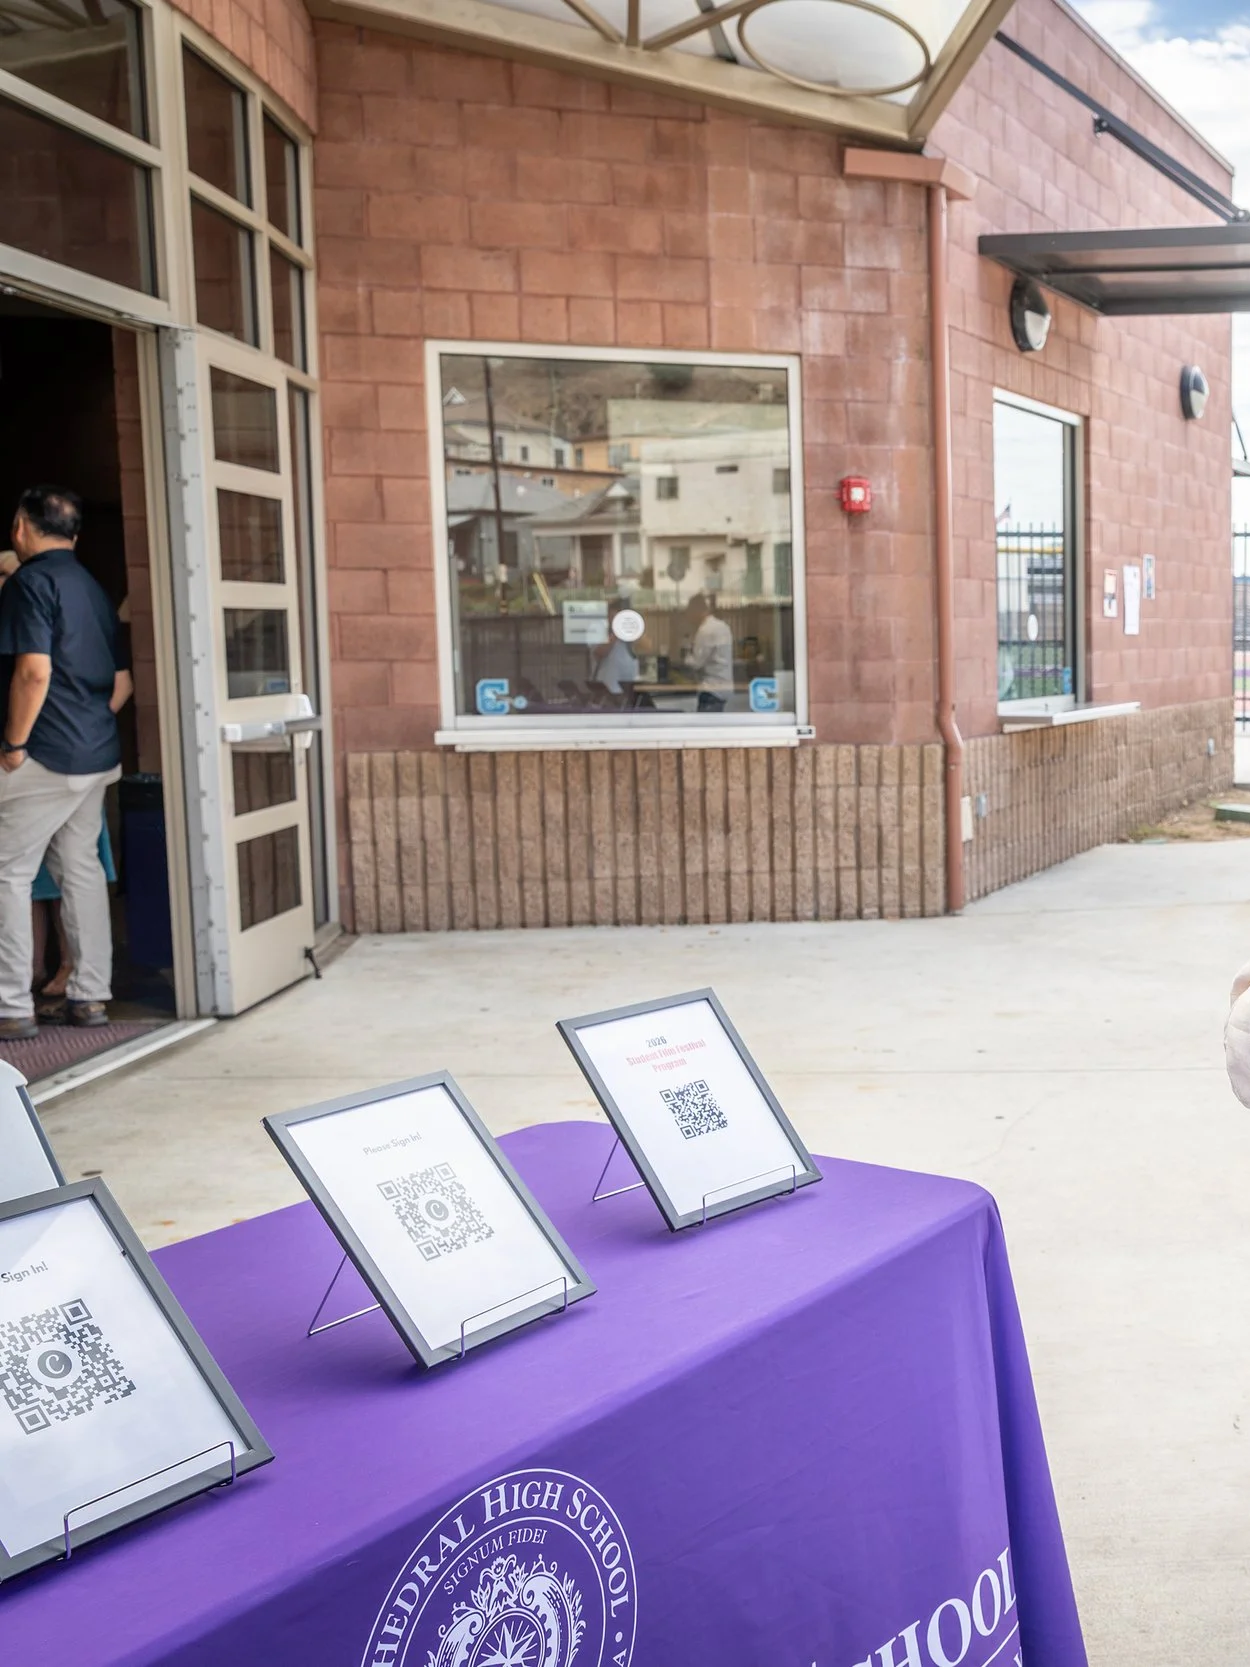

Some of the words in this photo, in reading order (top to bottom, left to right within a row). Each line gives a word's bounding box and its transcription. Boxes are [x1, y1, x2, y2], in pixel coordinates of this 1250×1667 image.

[626, 1051, 659, 1066] Student
[657, 1047, 677, 1058] Film
[675, 1039, 706, 1054] Festival
[645, 1036, 667, 1048] 2026
[652, 1058, 687, 1073] Program
[363, 1143, 391, 1155] Please
[390, 1137, 411, 1148] Sign
[408, 1131, 422, 1142] In!
[0, 1269, 30, 1283] Sign
[30, 1261, 48, 1275] In!
[481, 1481, 564, 1524] HIGH
[566, 1488, 630, 1618] SCHOOL
[443, 1536, 504, 1596] SIGNUM
[507, 1528, 548, 1547] FIDEI
